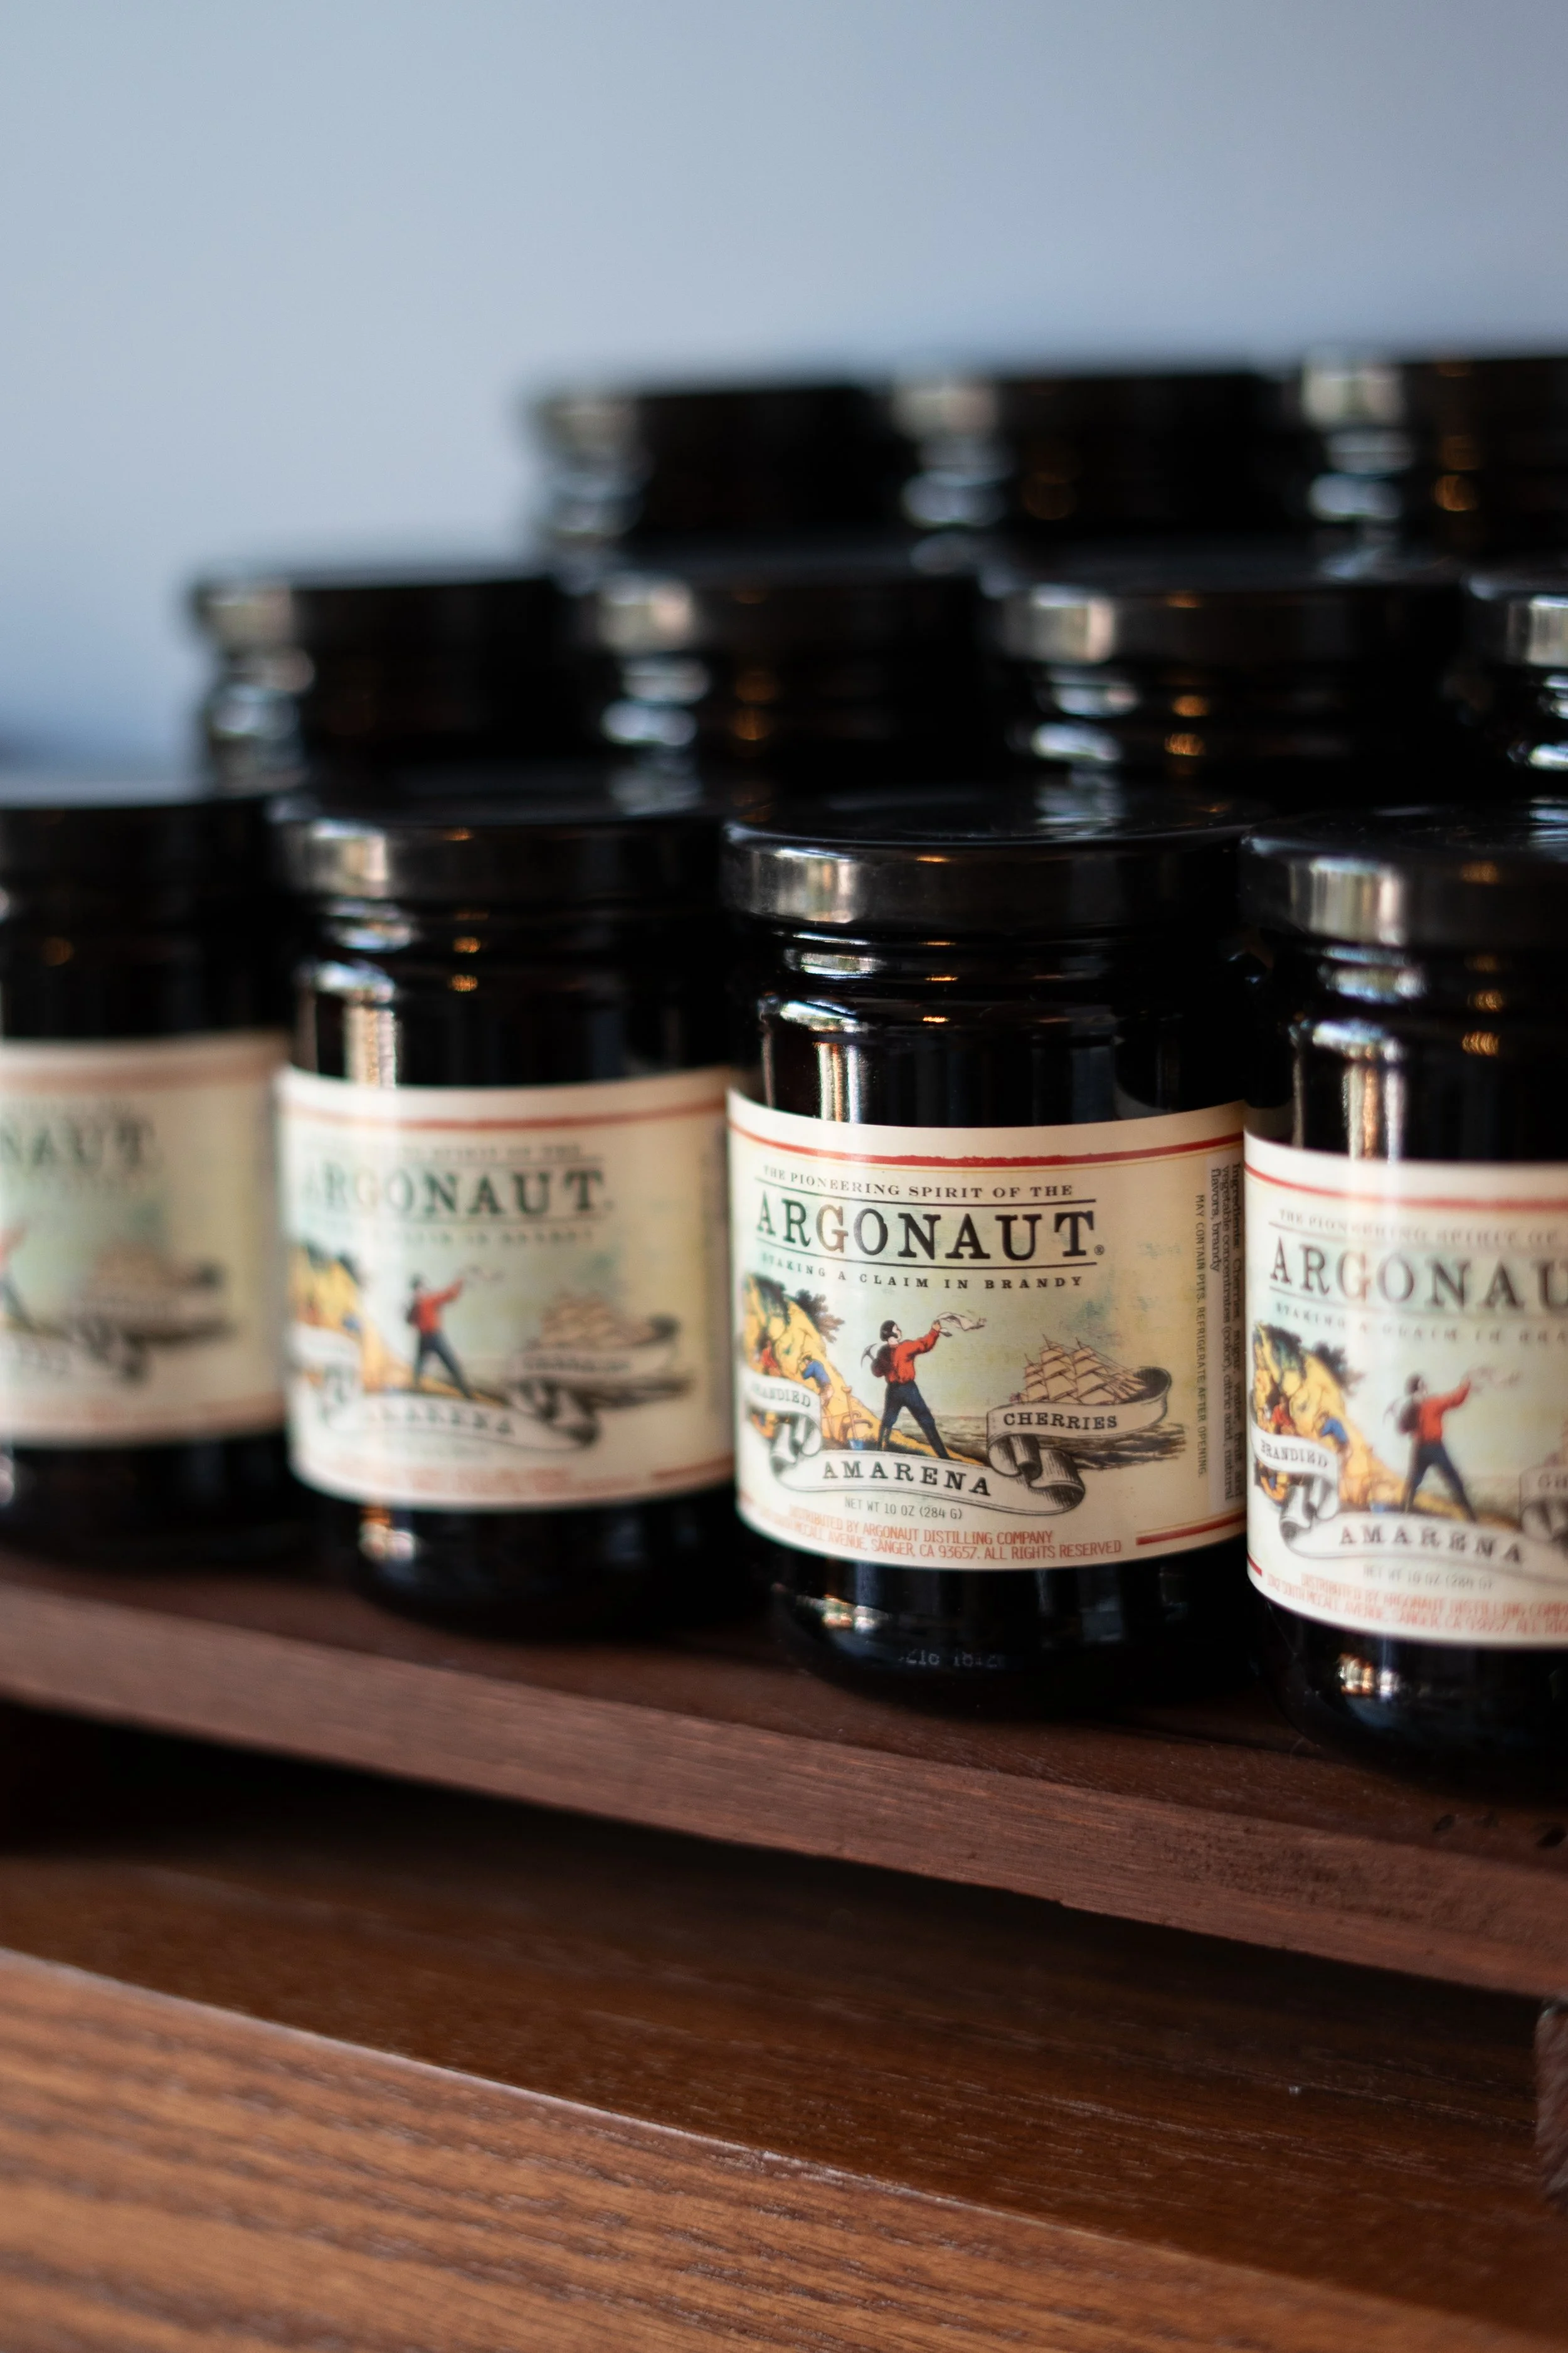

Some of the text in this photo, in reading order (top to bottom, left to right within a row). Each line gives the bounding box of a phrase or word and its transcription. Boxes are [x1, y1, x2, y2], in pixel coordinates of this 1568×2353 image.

[763, 1165, 1073, 1198] THE PIONEERING SPIRIT OF THE
[1221, 1166, 1231, 1231] vegetable
[1210, 1168, 1221, 1273] flavors, brandy
[838, 1271, 846, 1280] A
[859, 1273, 928, 1288] CLAIM
[945, 1279, 968, 1290] IN
[985, 1277, 1082, 1290] BRANDY
[1222, 1235, 1232, 1323] concentrates
[1195, 1194, 1207, 1478] MAY CONTAIN PITS. REFRIGERATE AFTER OPENING.
[1224, 1374, 1233, 1410] citric
[1004, 1412, 1117, 1430] CHERRIES
[822, 1460, 991, 1497] AMARENA
[1224, 1449, 1234, 1501] natural
[845, 1496, 963, 1520] NET WT 10 OZ (284 G)
[847, 1519, 860, 1534] BY
[863, 1522, 919, 1541] ARGONAUT
[924, 1530, 993, 1545] DISTILLING
[997, 1530, 1054, 1546] COMPANY
[919, 1544, 935, 1558] CA
[938, 1545, 981, 1560] 93657.
[984, 1546, 1007, 1561] ALL
[1012, 1546, 1056, 1560] RIGHTS
[1059, 1539, 1122, 1558] RESERVED
[1340, 1524, 1522, 1564] AMARENA
